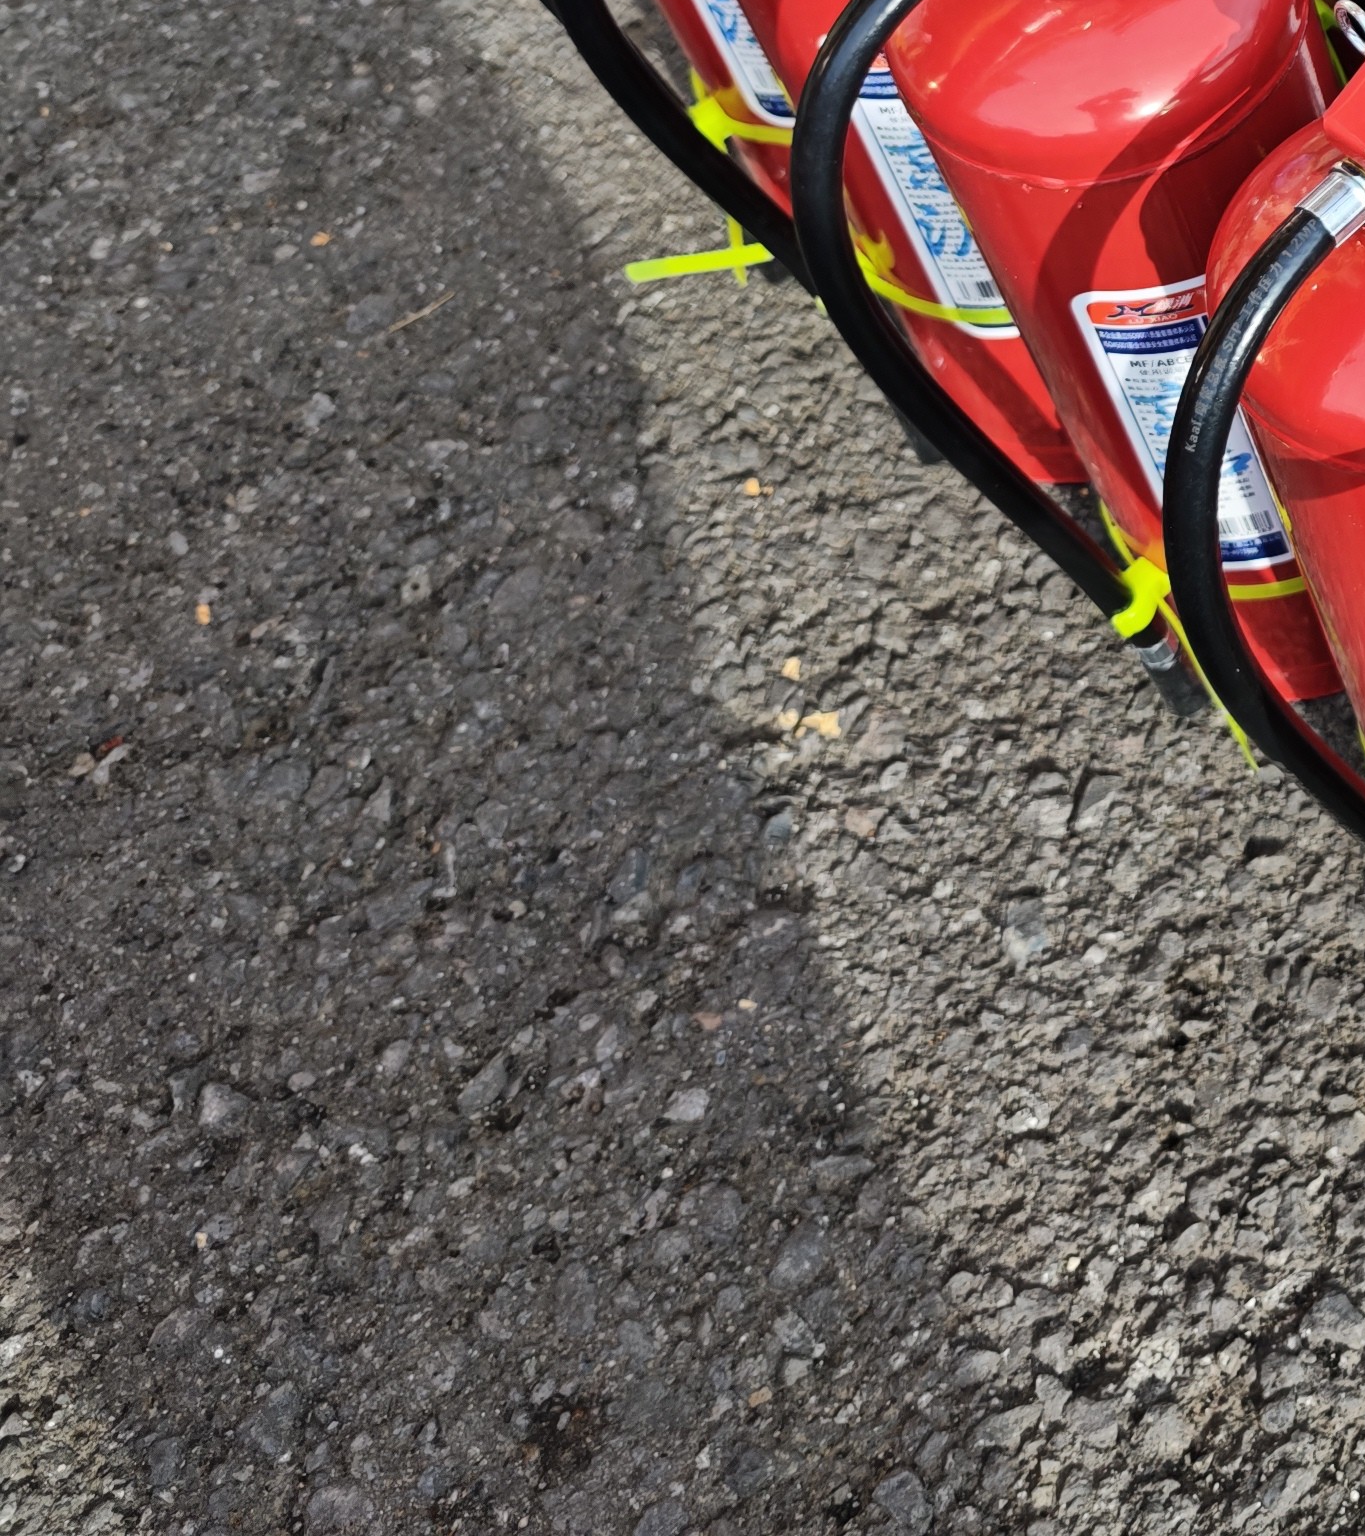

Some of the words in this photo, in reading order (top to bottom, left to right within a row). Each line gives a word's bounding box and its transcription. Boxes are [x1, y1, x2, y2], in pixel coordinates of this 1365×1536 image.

[1221, 320, 1243, 354] SFP
[1237, 260, 1286, 322] 工作压力
